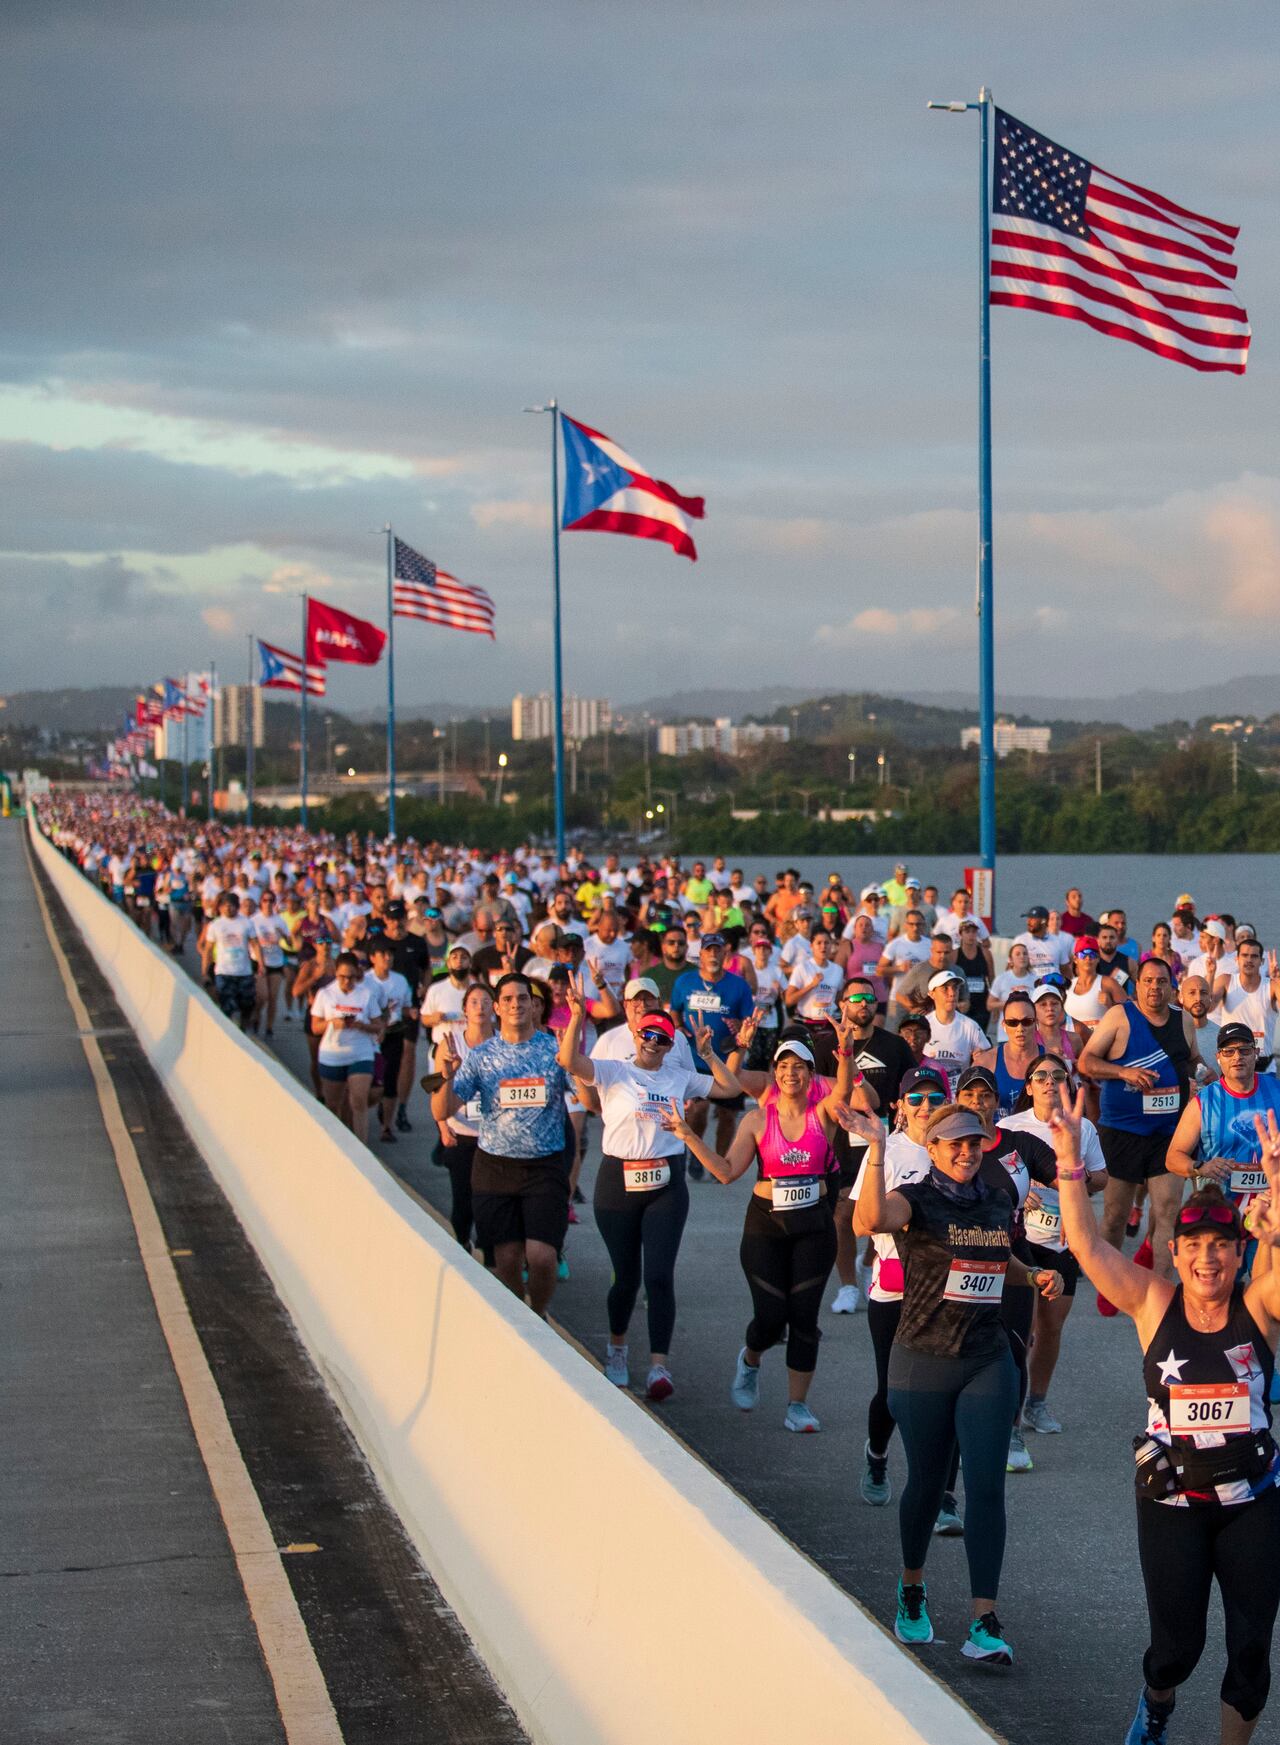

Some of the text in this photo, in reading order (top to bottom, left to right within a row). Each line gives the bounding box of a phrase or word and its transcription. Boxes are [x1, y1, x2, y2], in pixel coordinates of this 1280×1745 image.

[937, 1050, 956, 1059] 10K
[510, 1088, 537, 1101] 3143
[648, 1092, 669, 1103] 10K
[1151, 1095, 1175, 1108] 2513
[634, 1169, 662, 1184] 3816
[783, 1186, 812, 1202] 7006
[960, 1274, 996, 1293] 3407
[1187, 1400, 1234, 1422] 3067
